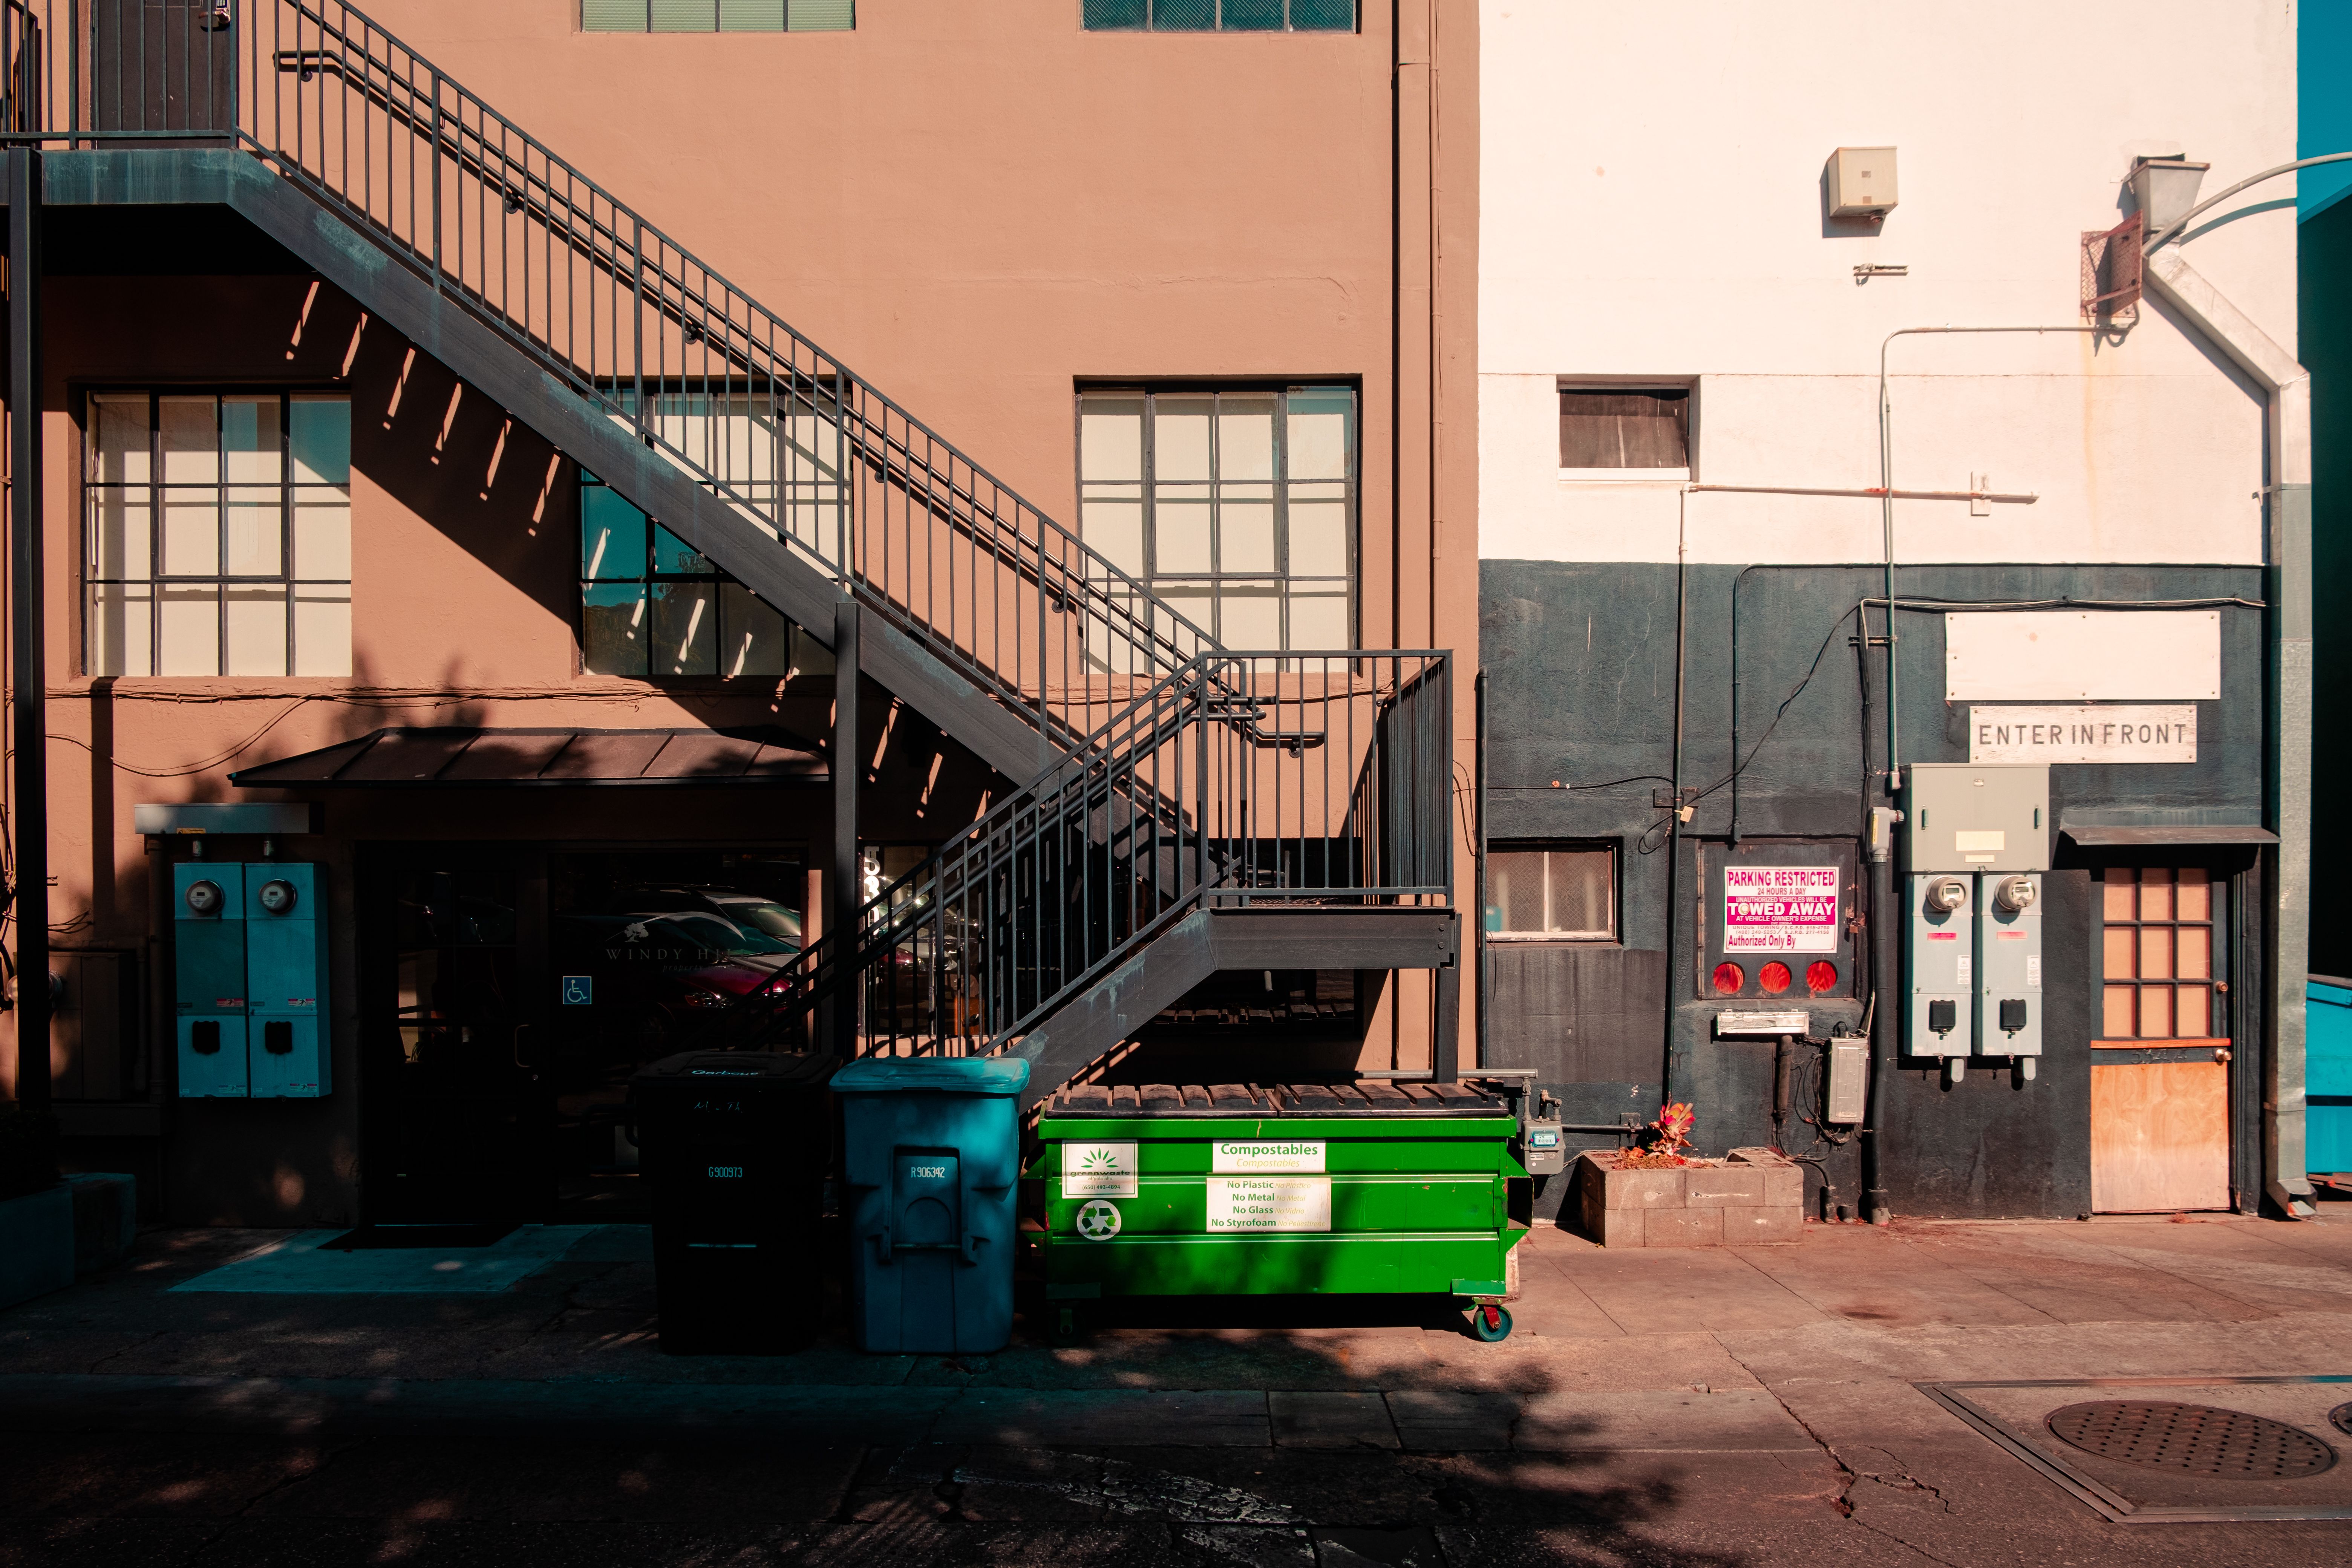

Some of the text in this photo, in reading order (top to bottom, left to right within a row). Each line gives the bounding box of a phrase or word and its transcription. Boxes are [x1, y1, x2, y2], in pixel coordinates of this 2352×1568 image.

[1979, 723, 2186, 745] ENTER IN FRONT
[1727, 871, 1834, 886] PARKING RESTRICTED
[1727, 903, 1834, 915] TOWED AWAY
[1728, 935, 1796, 949] Authorized Only By
[605, 948, 682, 960] WINDY
[1221, 1143, 1318, 1158] Compostables
[1237, 1159, 1300, 1168] Compostables
[709, 1167, 743, 1178] G900973
[1243, 1180, 1274, 1188] Plastic
[1248, 1193, 1275, 1201] Metal
[1248, 1206, 1273, 1214] Glass
[1227, 1218, 1276, 1228] Styrofoam
